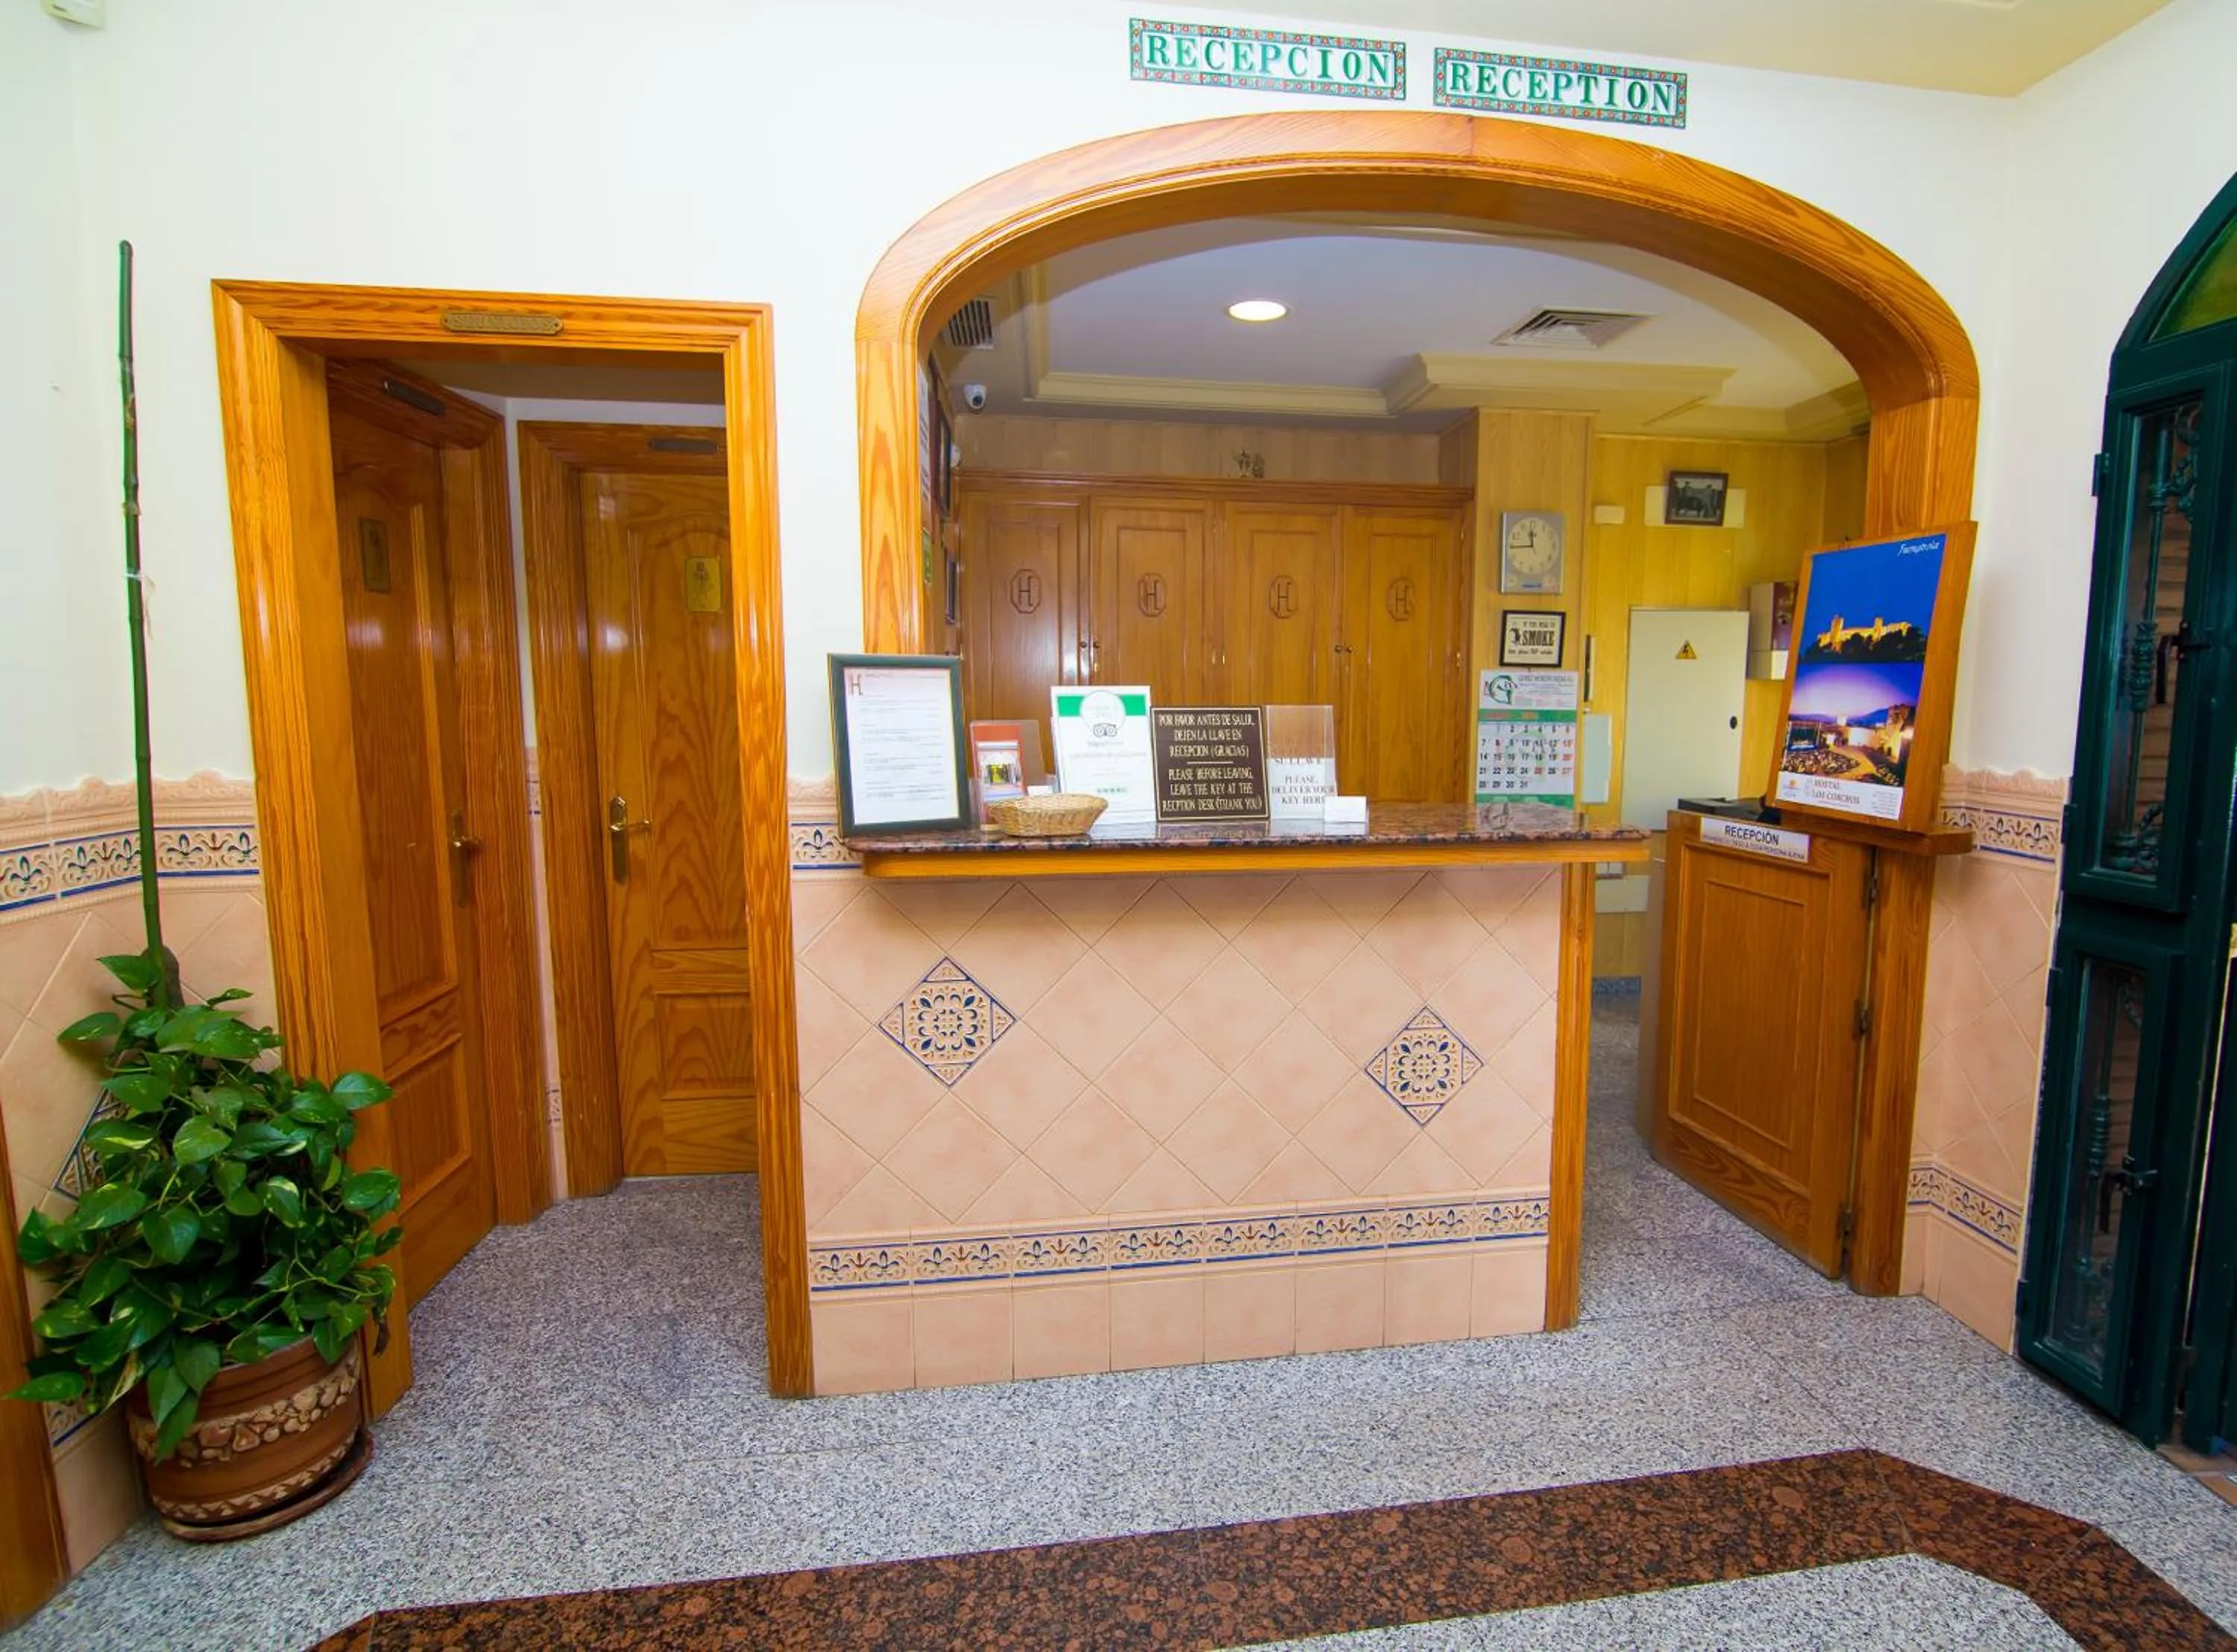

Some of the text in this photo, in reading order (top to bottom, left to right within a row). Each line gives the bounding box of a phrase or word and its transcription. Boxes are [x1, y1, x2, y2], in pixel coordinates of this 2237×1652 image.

[1145, 34, 1391, 84] RECEPCION
[1449, 61, 1674, 113] RECEPTION
[1522, 630, 1555, 646] SMOKE
[1160, 713, 1174, 726] POR
[1174, 713, 1195, 725] FAVOR
[1197, 713, 1221, 725] ANTES
[1222, 713, 1231, 725] DE
[1174, 729, 1242, 741] DEJEN LA LLAVE EN
[1210, 745, 1249, 757] (GRACIAS)
[1168, 768, 1193, 781] PLEASE
[1197, 767, 1223, 780] BEFORE
[1170, 782, 1253, 795] LEAVE THE KEY AT THE
[1198, 798, 1215, 811] DESK
[1215, 798, 1244, 811] (THANK
[1245, 796, 1263, 810] YOU)
[1725, 825, 1780, 846] RECEPCIÓN
